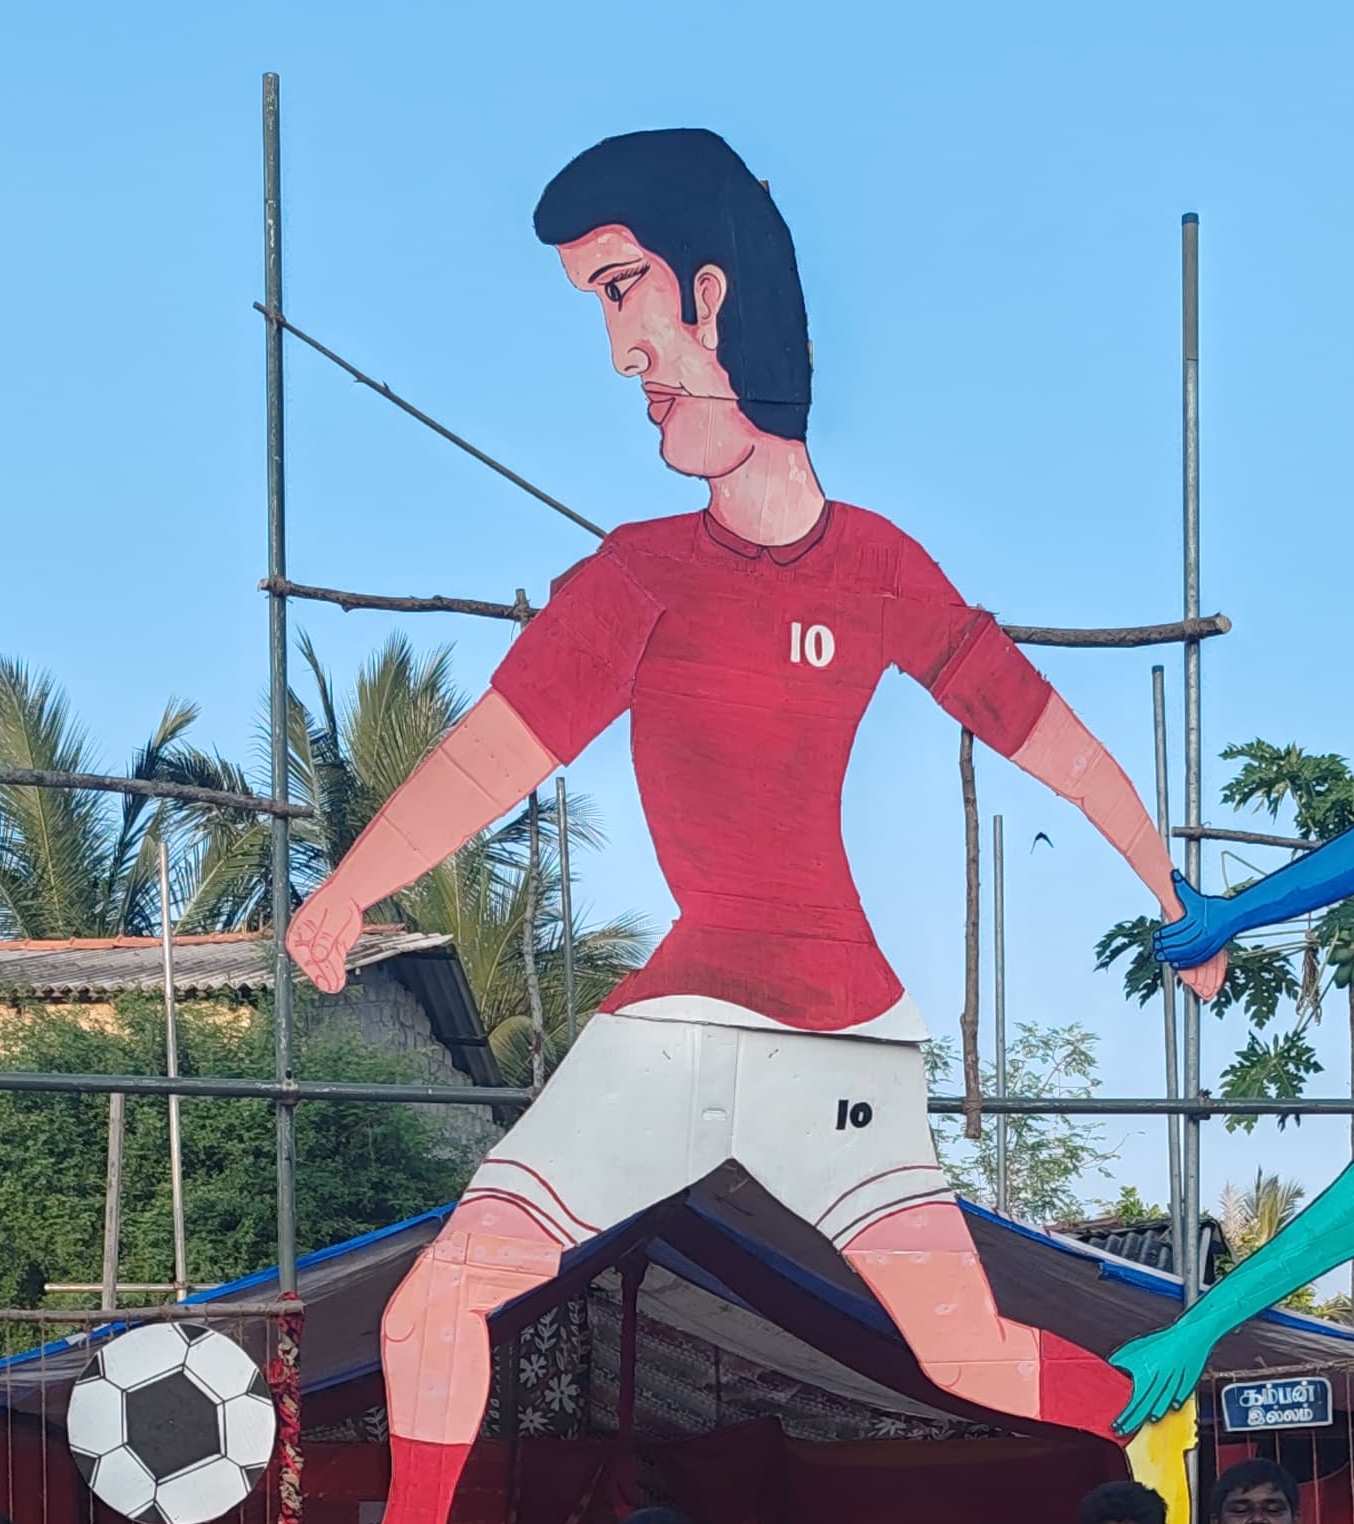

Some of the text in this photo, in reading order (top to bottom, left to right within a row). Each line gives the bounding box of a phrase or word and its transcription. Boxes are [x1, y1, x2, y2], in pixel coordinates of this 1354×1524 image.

[790, 621, 835, 668] 10
[835, 1099, 873, 1130] 10
[1247, 1403, 1314, 1425] இல்லம்
